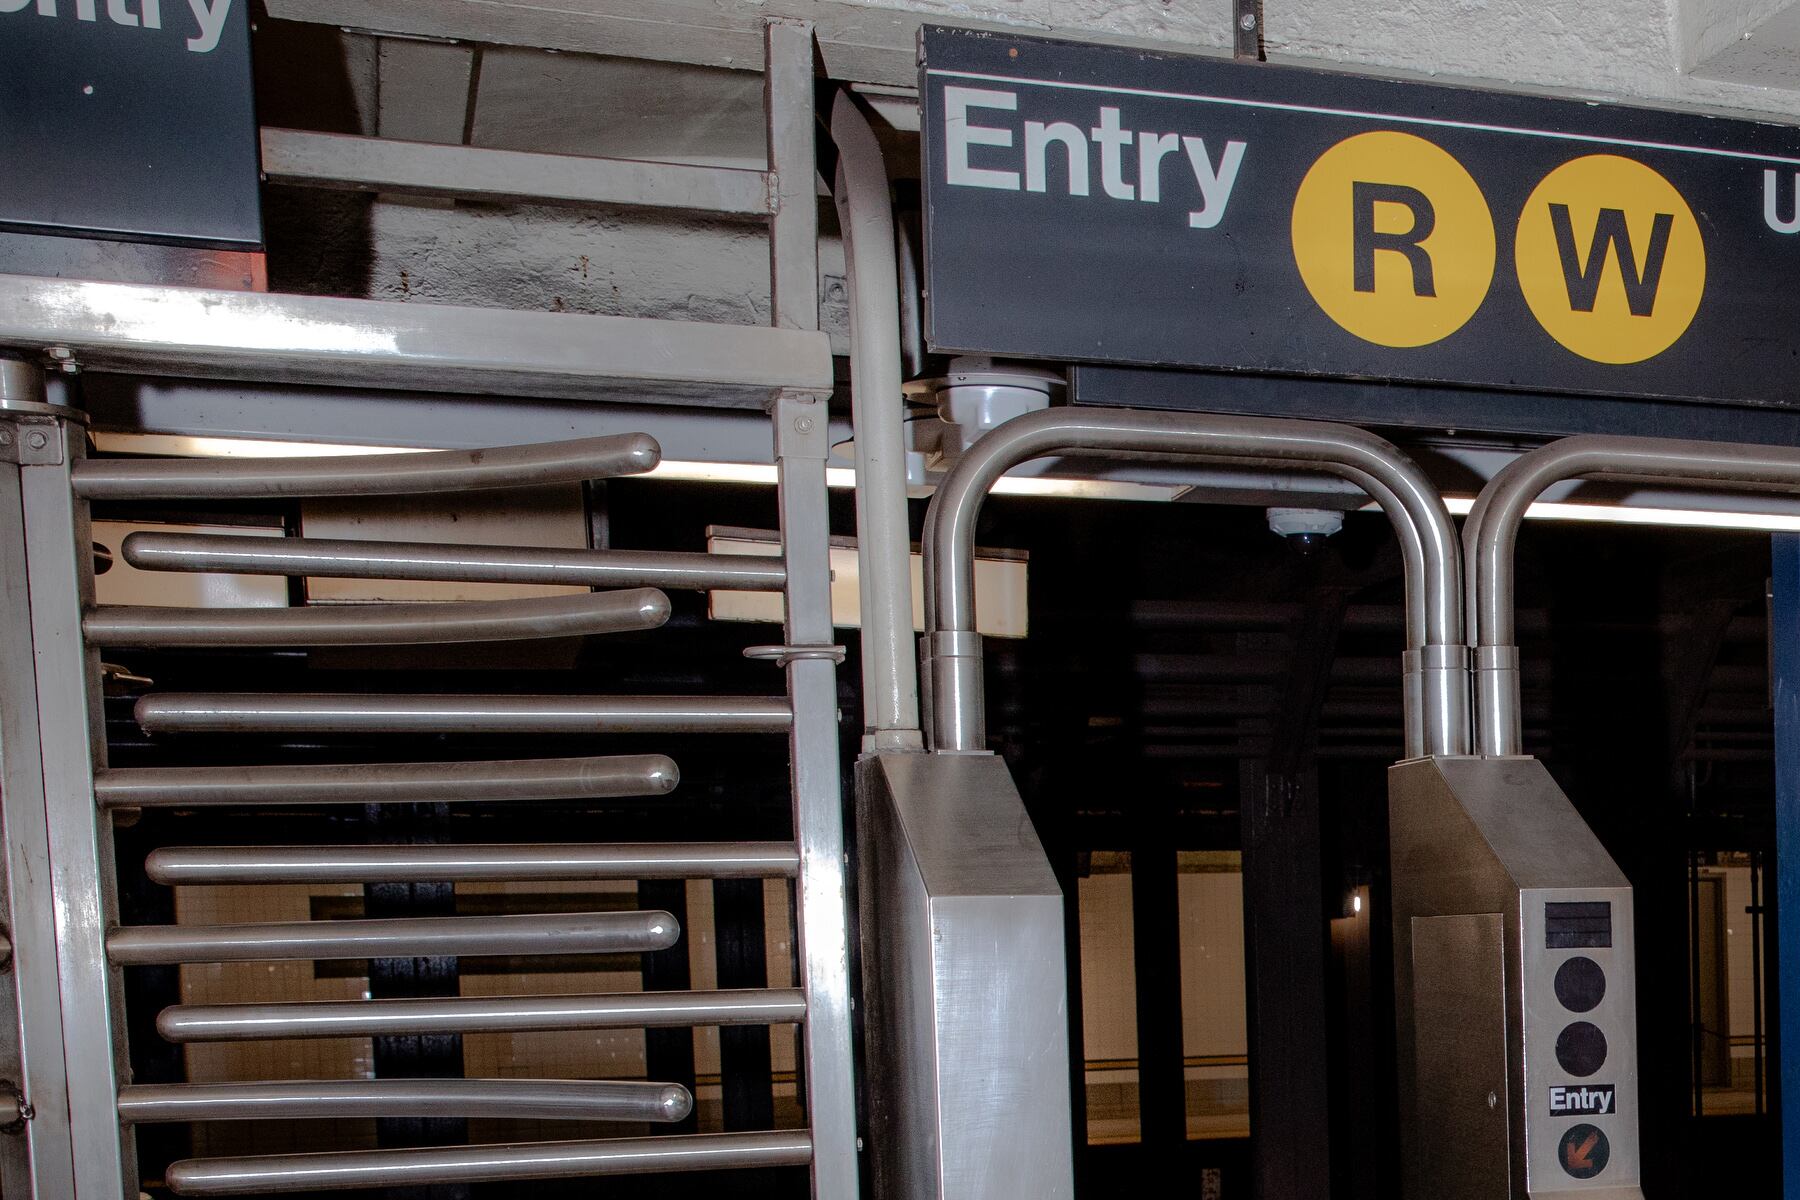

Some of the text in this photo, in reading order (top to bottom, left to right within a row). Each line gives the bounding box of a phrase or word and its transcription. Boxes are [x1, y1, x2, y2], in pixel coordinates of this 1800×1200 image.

[943, 85, 1247, 229] Entry
[1351, 181, 1437, 298] R
[1548, 202, 1675, 318] W
[1550, 1087, 1613, 1114] Entry
